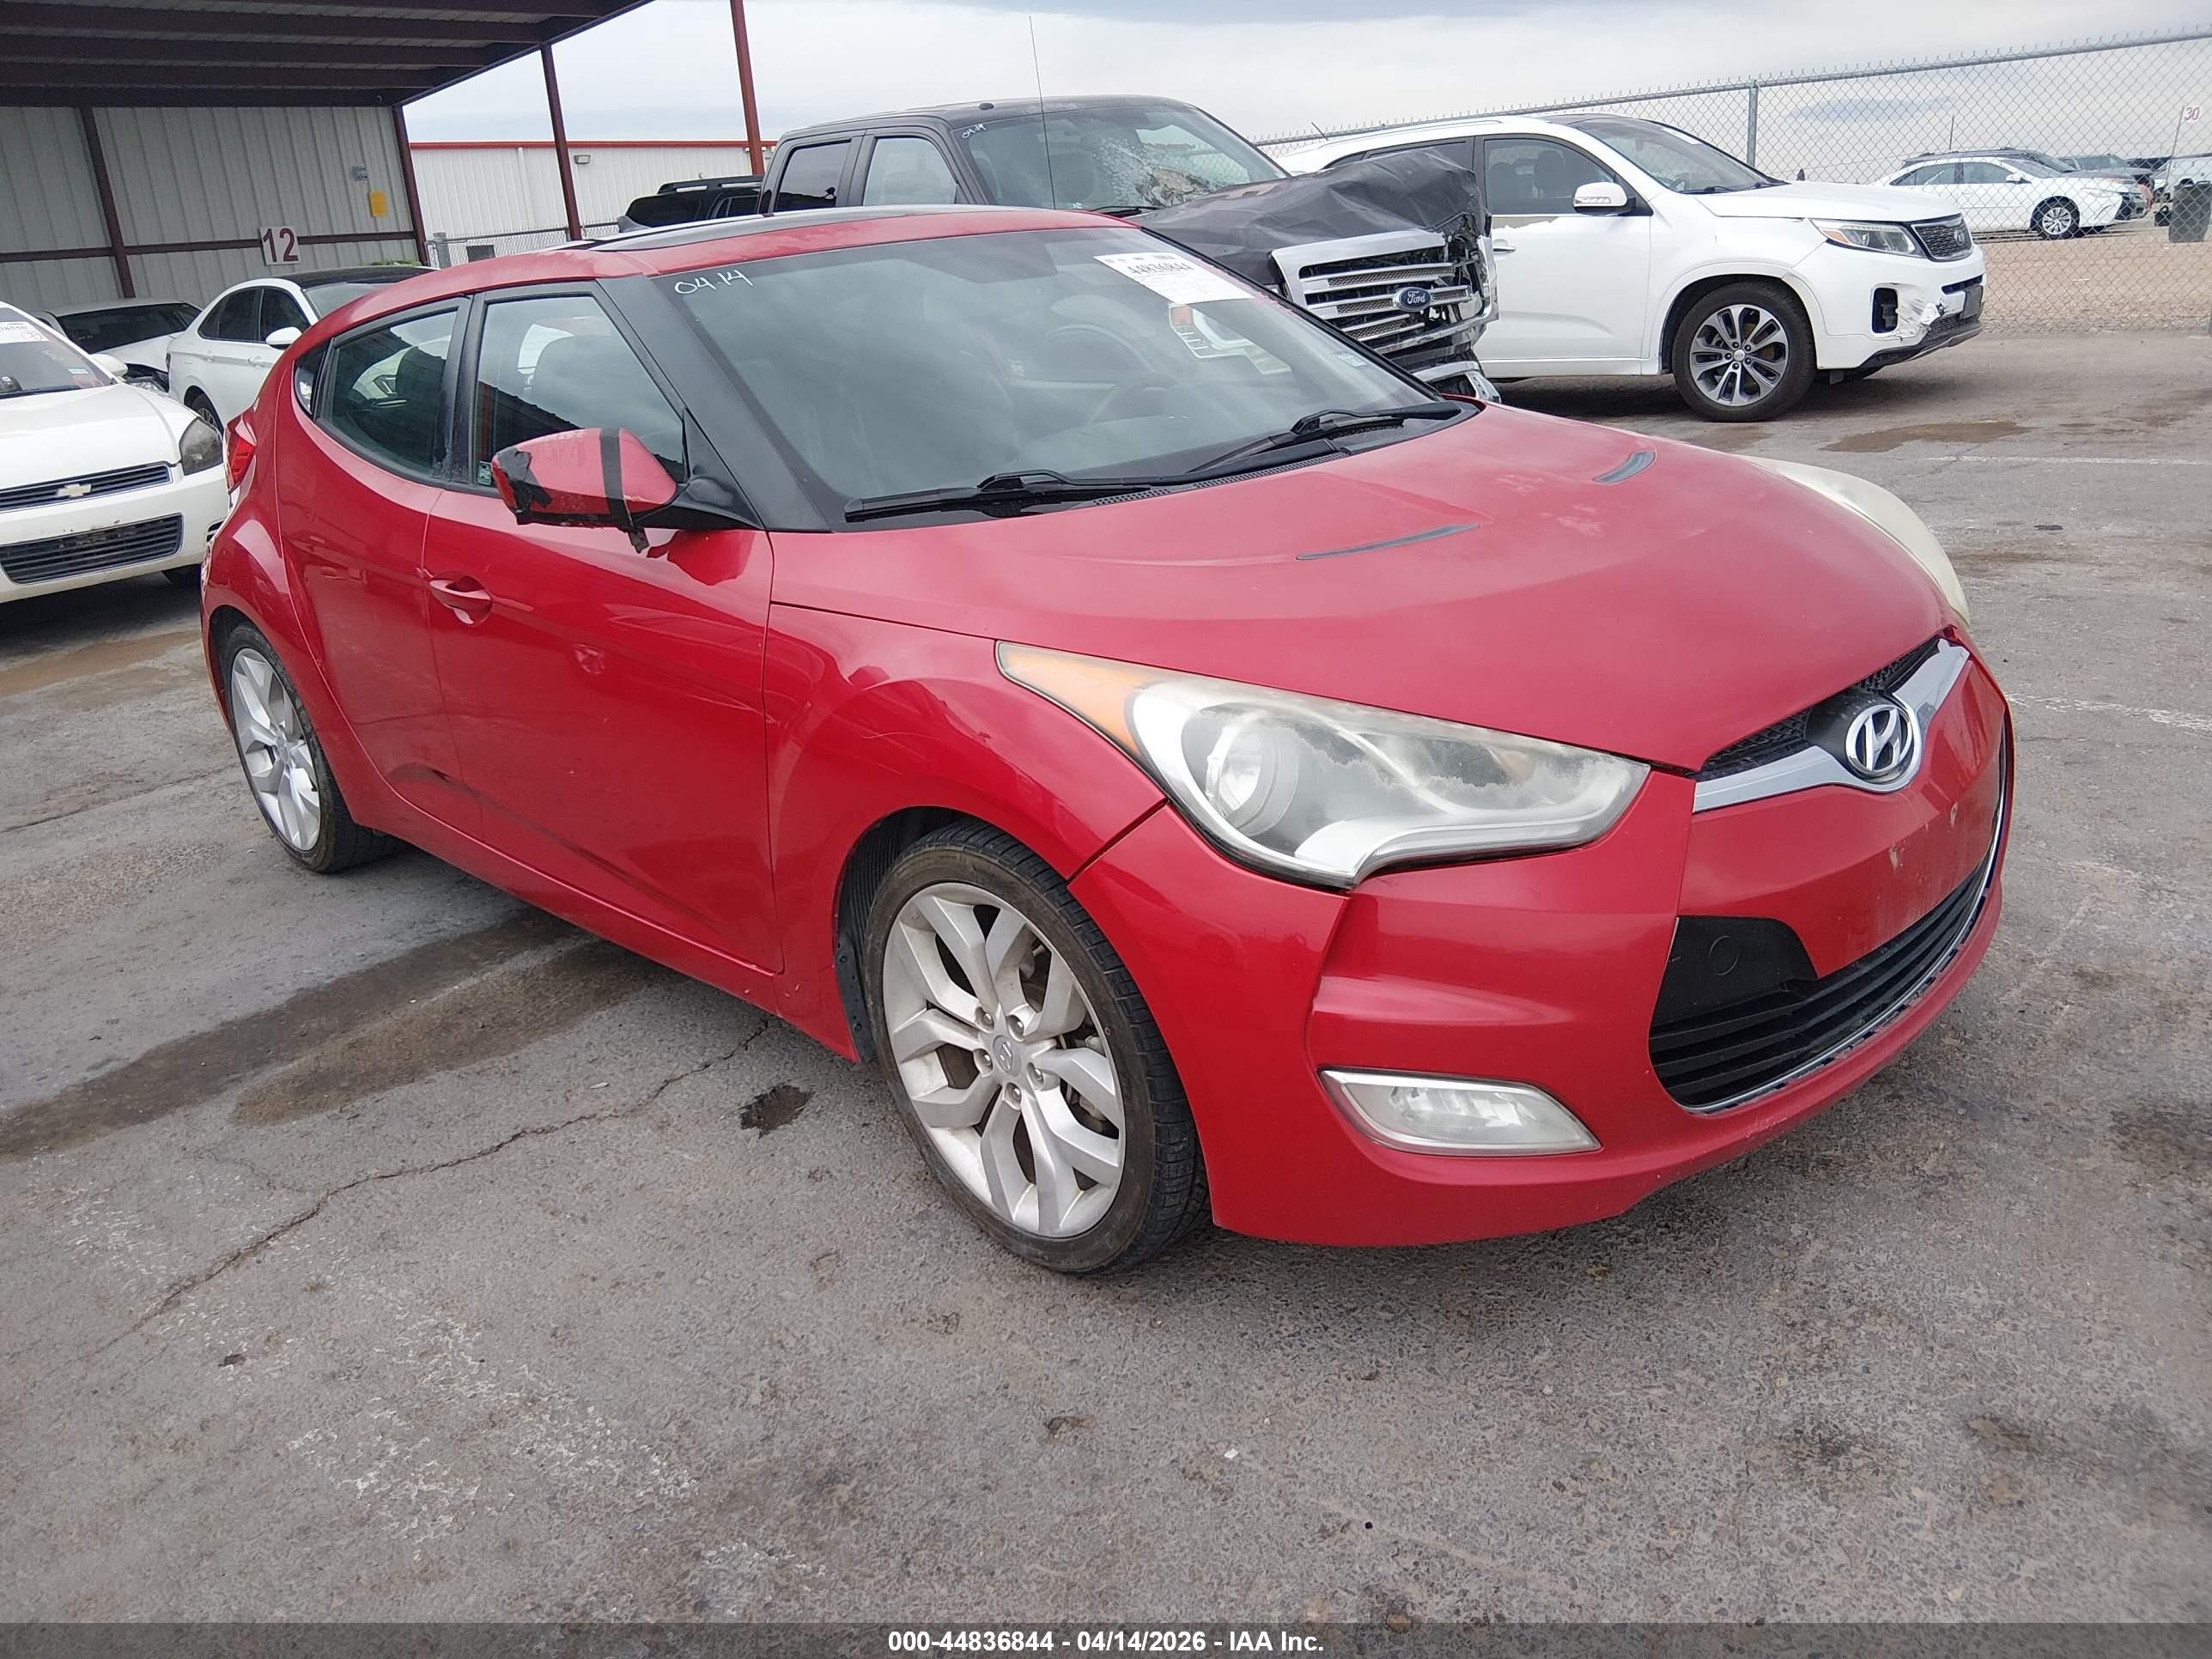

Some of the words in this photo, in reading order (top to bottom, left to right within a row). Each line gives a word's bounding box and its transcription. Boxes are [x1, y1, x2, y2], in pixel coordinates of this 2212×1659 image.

[2185, 106, 2199, 120] 30
[263, 228, 299, 263] 12
[1407, 290, 1426, 305] Ford
